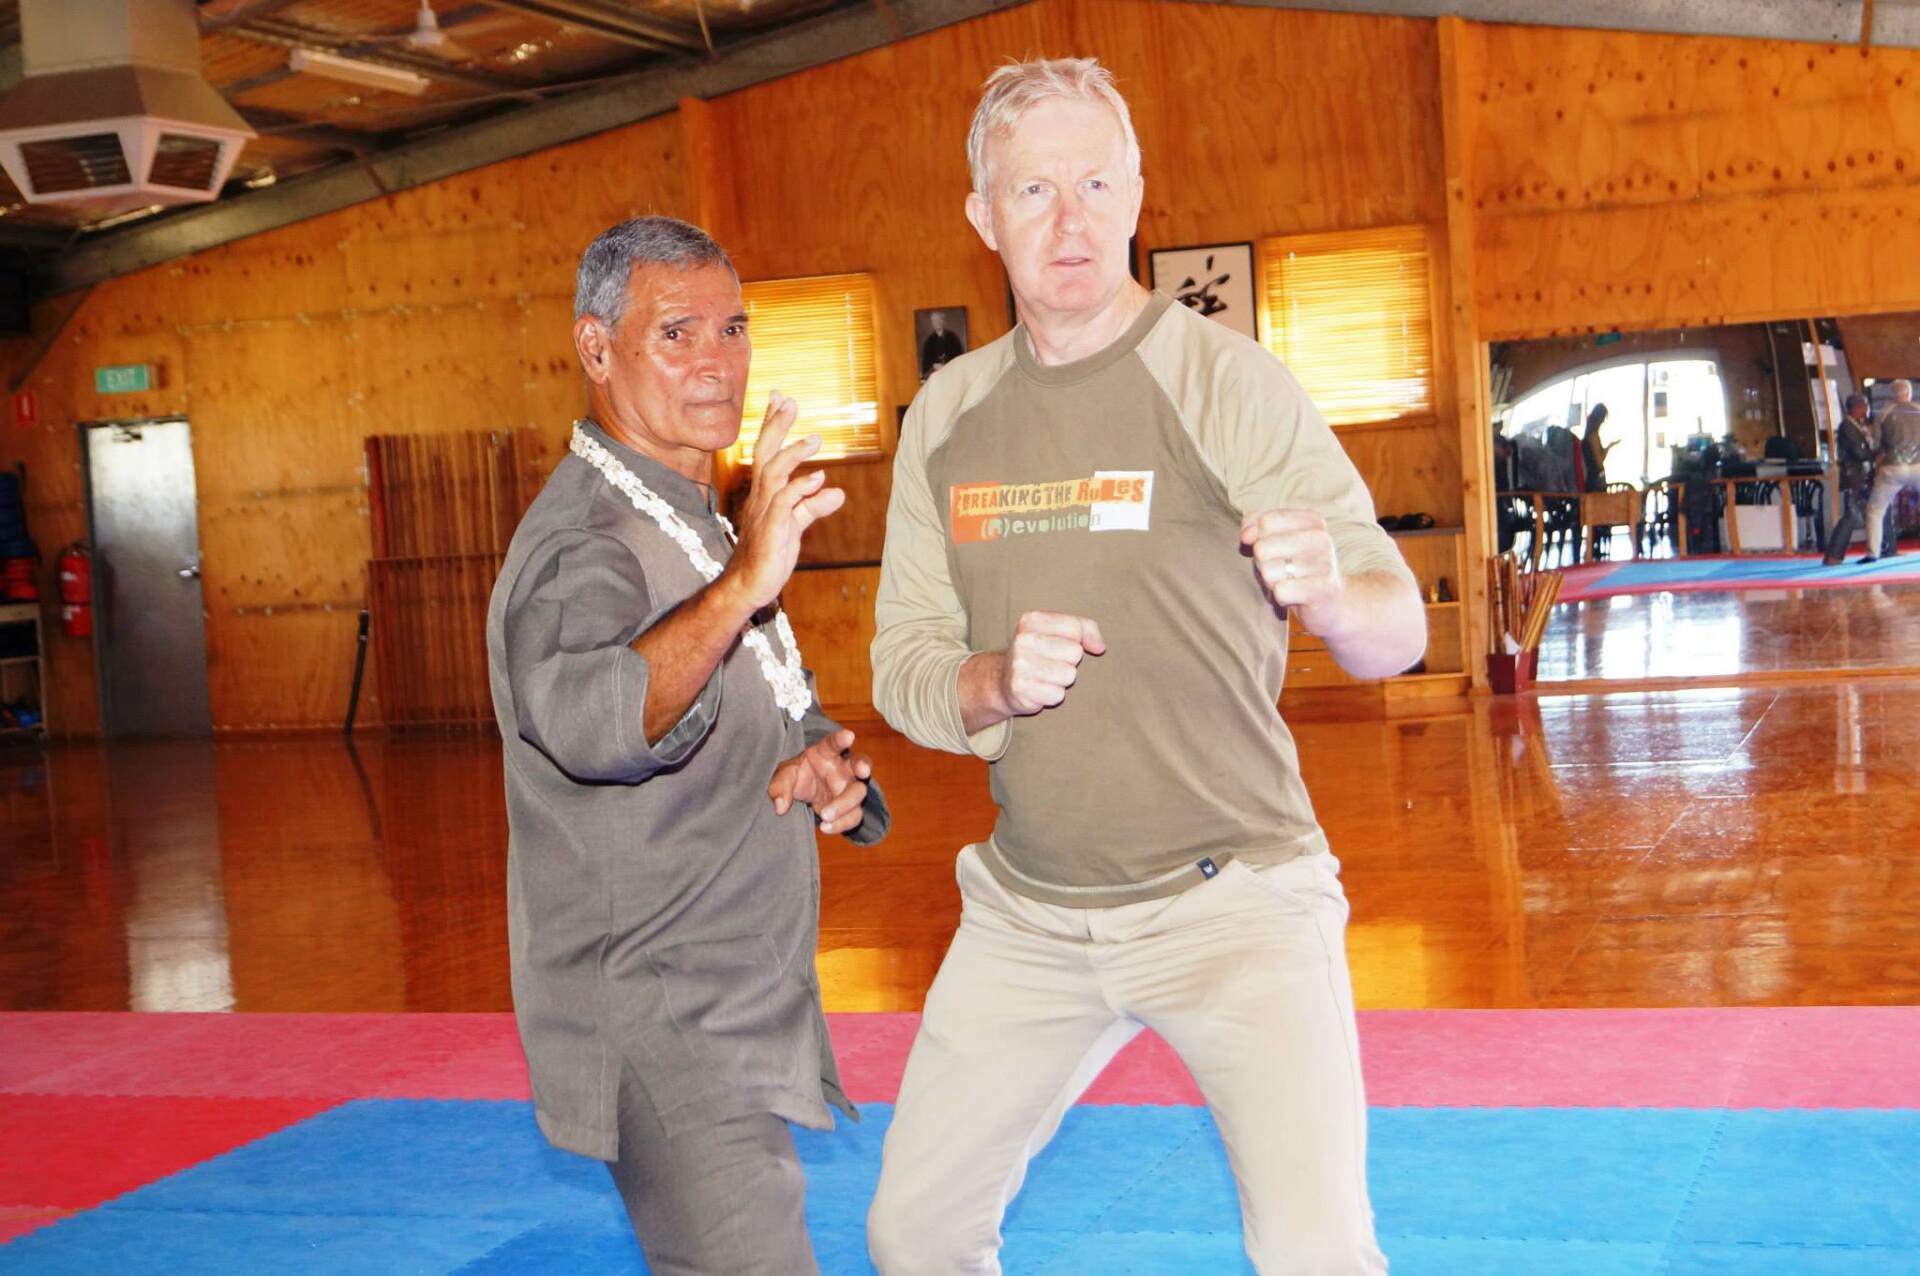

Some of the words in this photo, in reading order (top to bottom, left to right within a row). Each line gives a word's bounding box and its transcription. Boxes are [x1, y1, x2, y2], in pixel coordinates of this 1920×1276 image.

[106, 368, 136, 389] EXIT
[962, 488, 1041, 511] BREAKING
[1045, 485, 1072, 506] THE
